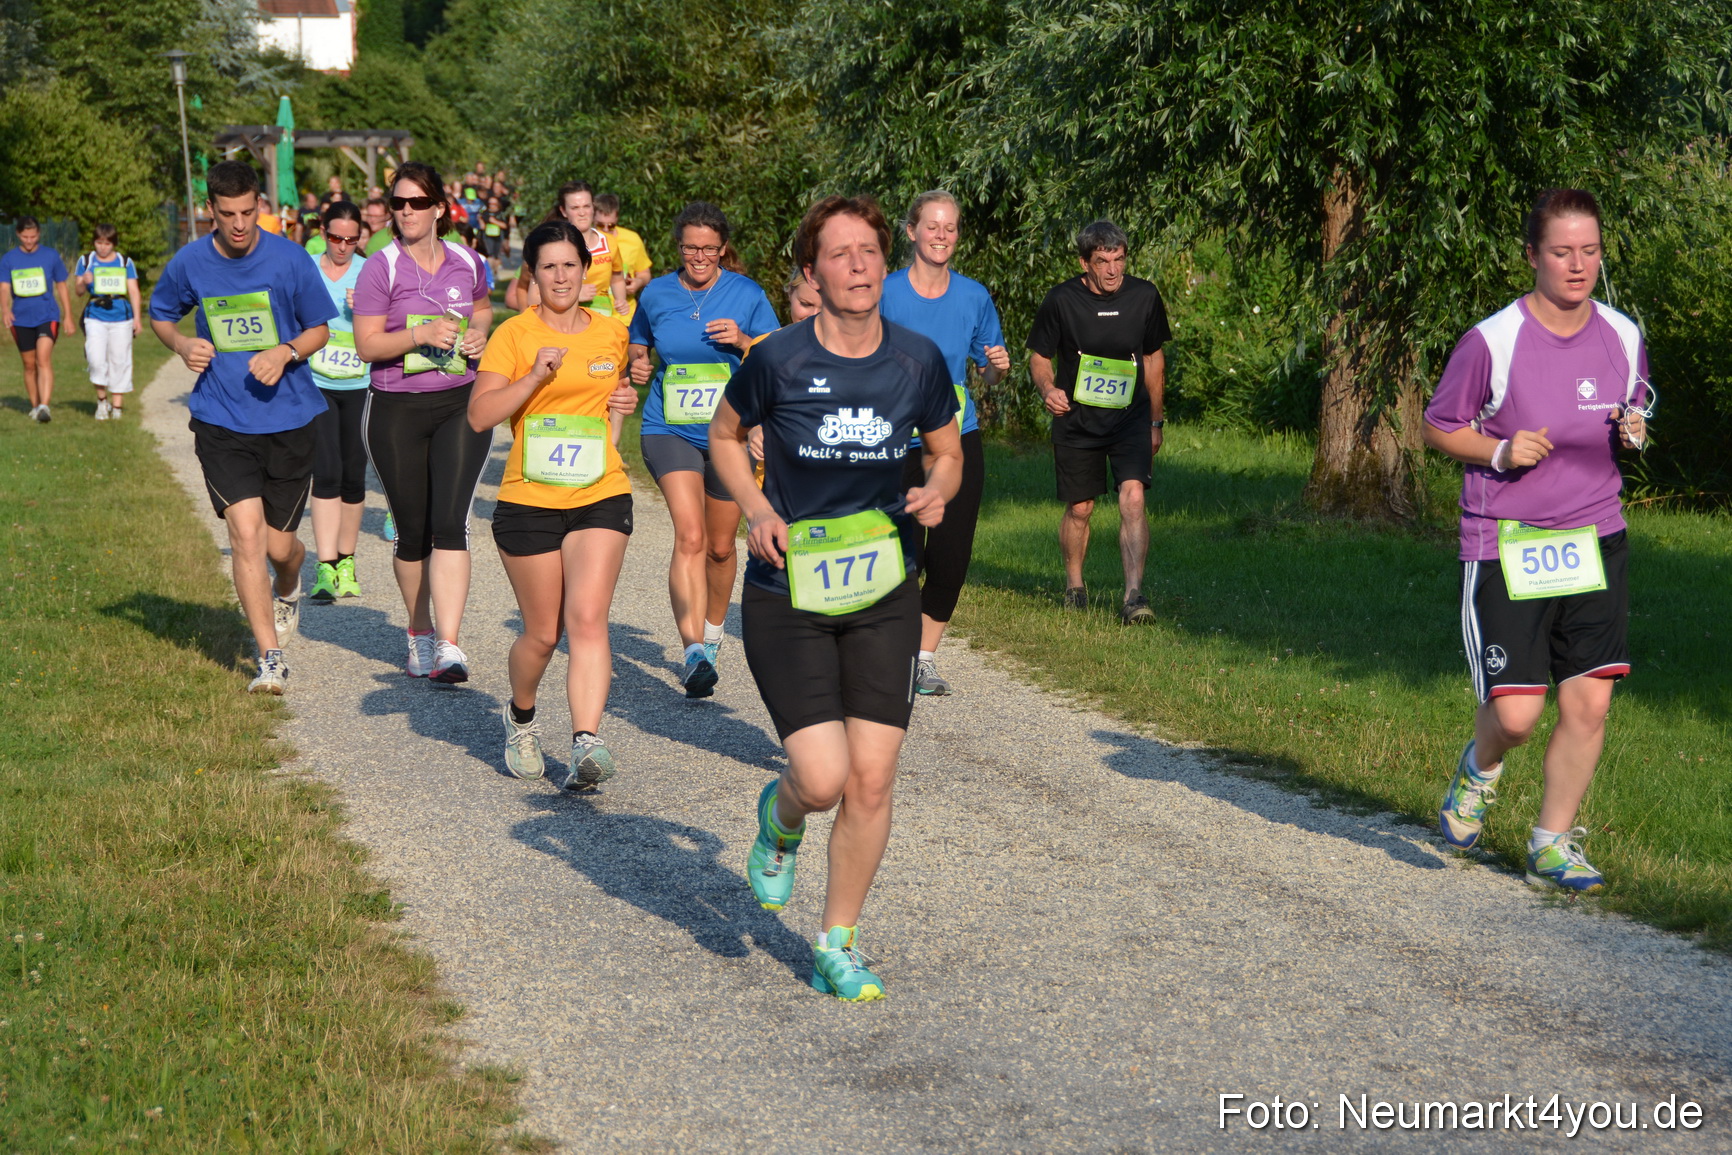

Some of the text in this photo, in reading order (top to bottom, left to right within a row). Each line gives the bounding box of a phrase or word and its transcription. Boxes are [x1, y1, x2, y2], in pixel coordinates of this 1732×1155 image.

[20, 279, 39, 288] 789
[101, 278, 120, 287] 808
[221, 316, 263, 336] 735
[319, 348, 361, 368] 1425
[1083, 376, 1127, 396] 1251
[676, 388, 717, 408] 727
[818, 414, 892, 446] Burgis
[548, 443, 582, 467] 47
[799, 445, 843, 459] Weil's
[849, 447, 889, 463] guad
[1521, 542, 1580, 575] 506
[814, 550, 878, 590] 177
[824, 593, 853, 602] Manuela
[853, 588, 876, 597] Mahler
